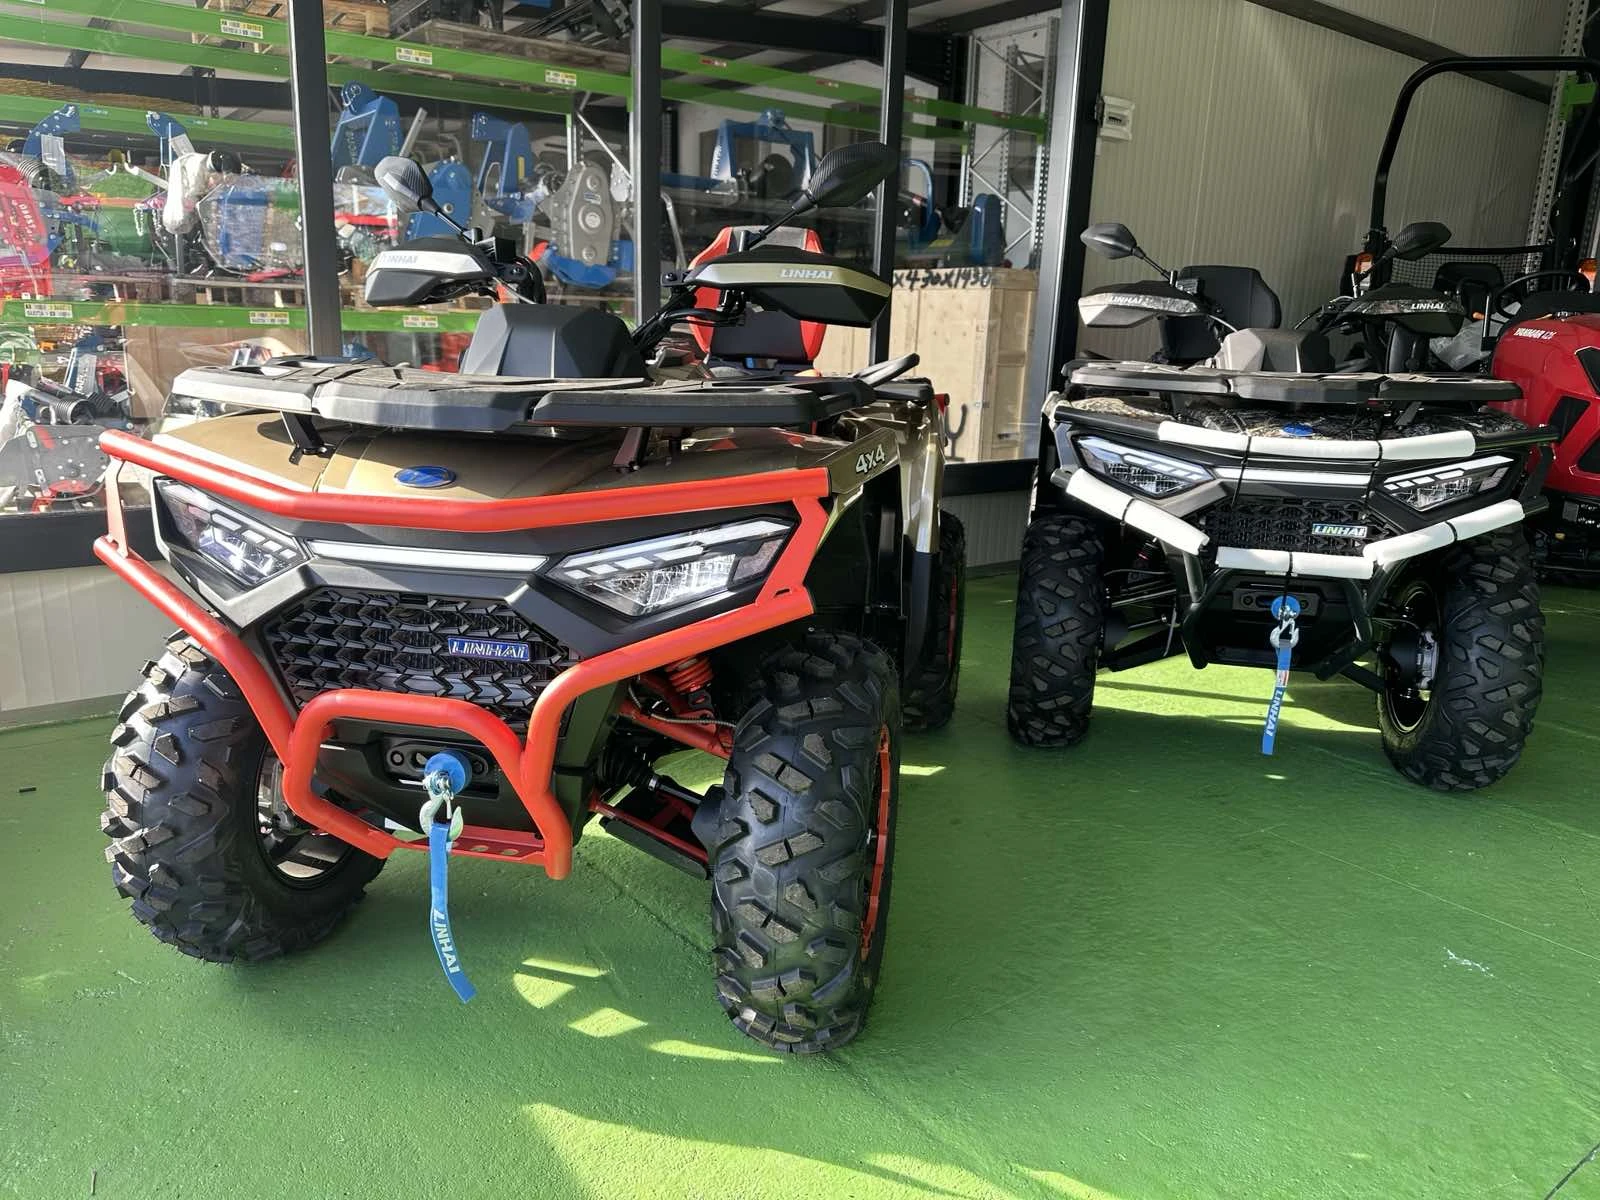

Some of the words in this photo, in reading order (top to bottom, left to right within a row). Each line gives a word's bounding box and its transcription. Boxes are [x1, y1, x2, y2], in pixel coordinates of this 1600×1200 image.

[781, 269, 833, 279] LINHAI
[1110, 295, 1144, 305] LINHAI
[1410, 302, 1445, 311] LINHAI
[1314, 525, 1364, 537] LINHAI
[452, 641, 526, 659] LINHAI
[1265, 689, 1283, 737] LINHAI
[433, 908, 460, 974] LINHAI
